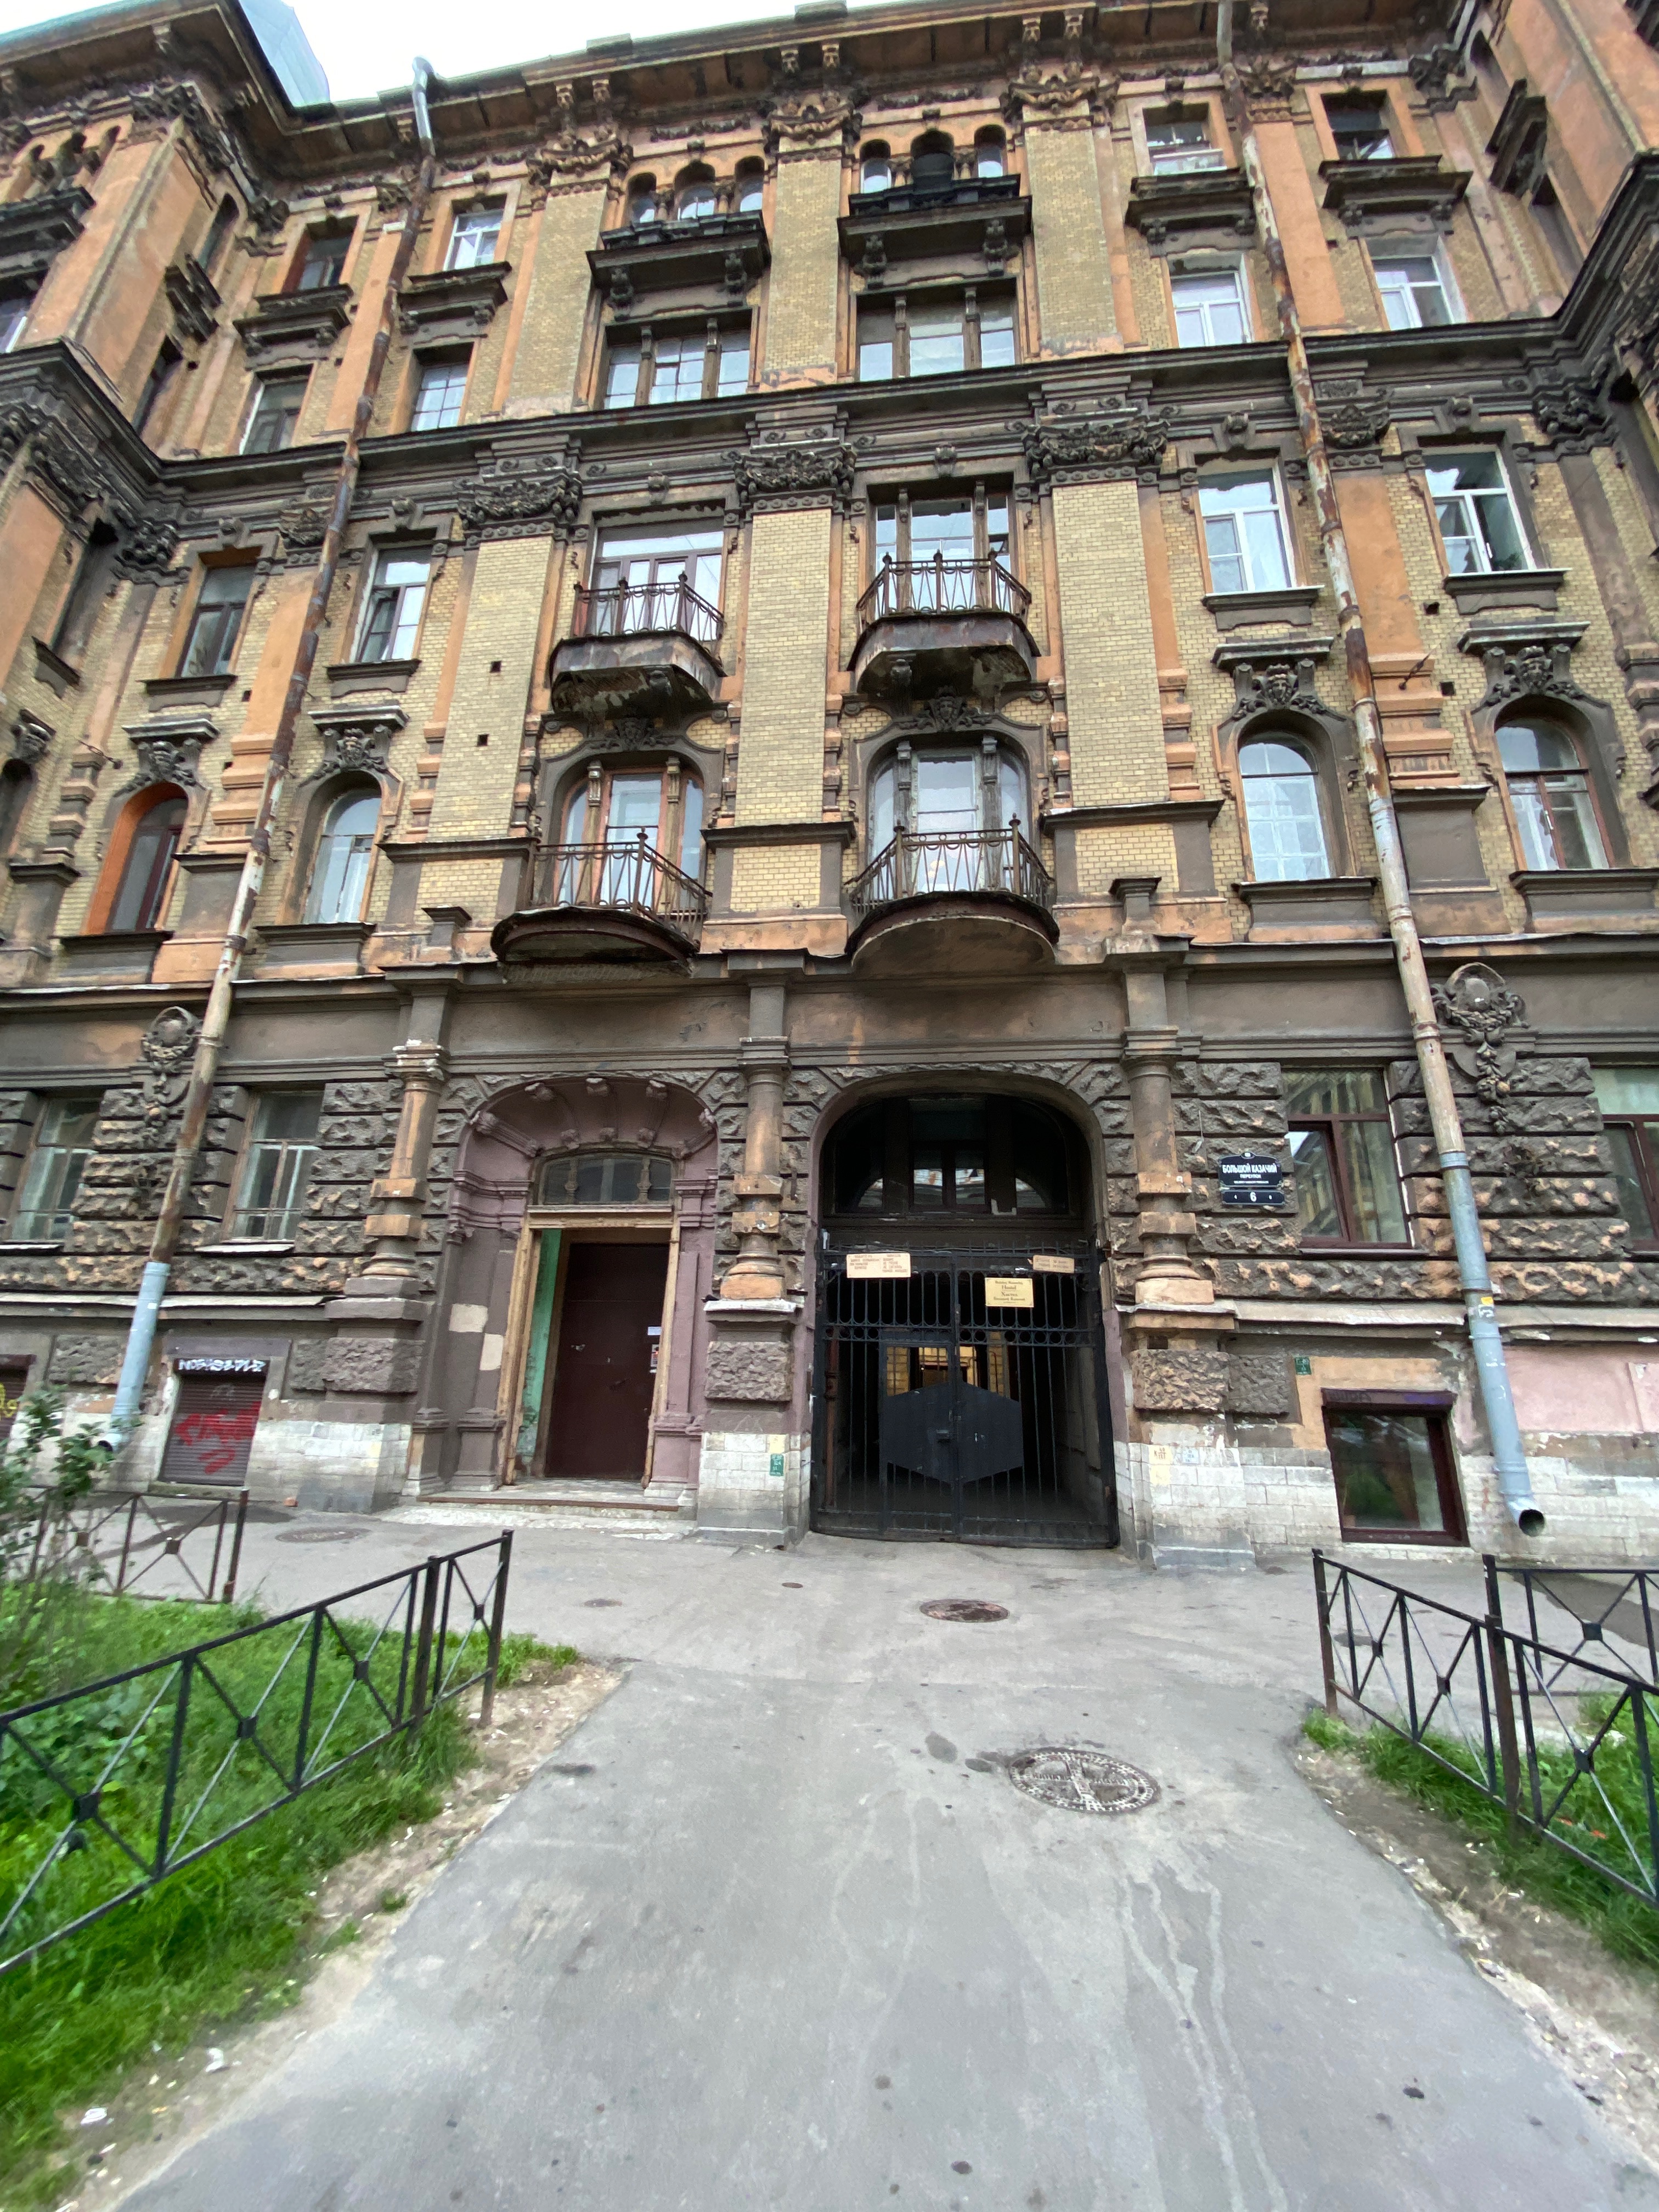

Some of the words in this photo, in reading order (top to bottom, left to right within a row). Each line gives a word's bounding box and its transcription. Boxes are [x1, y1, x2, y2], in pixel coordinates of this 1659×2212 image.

[1222, 1163, 1251, 1173] БОЛЬШОЙ
[1251, 1163, 1277, 1173] КАЗАЧИЙ
[1250, 1192, 1257, 1202] 6
